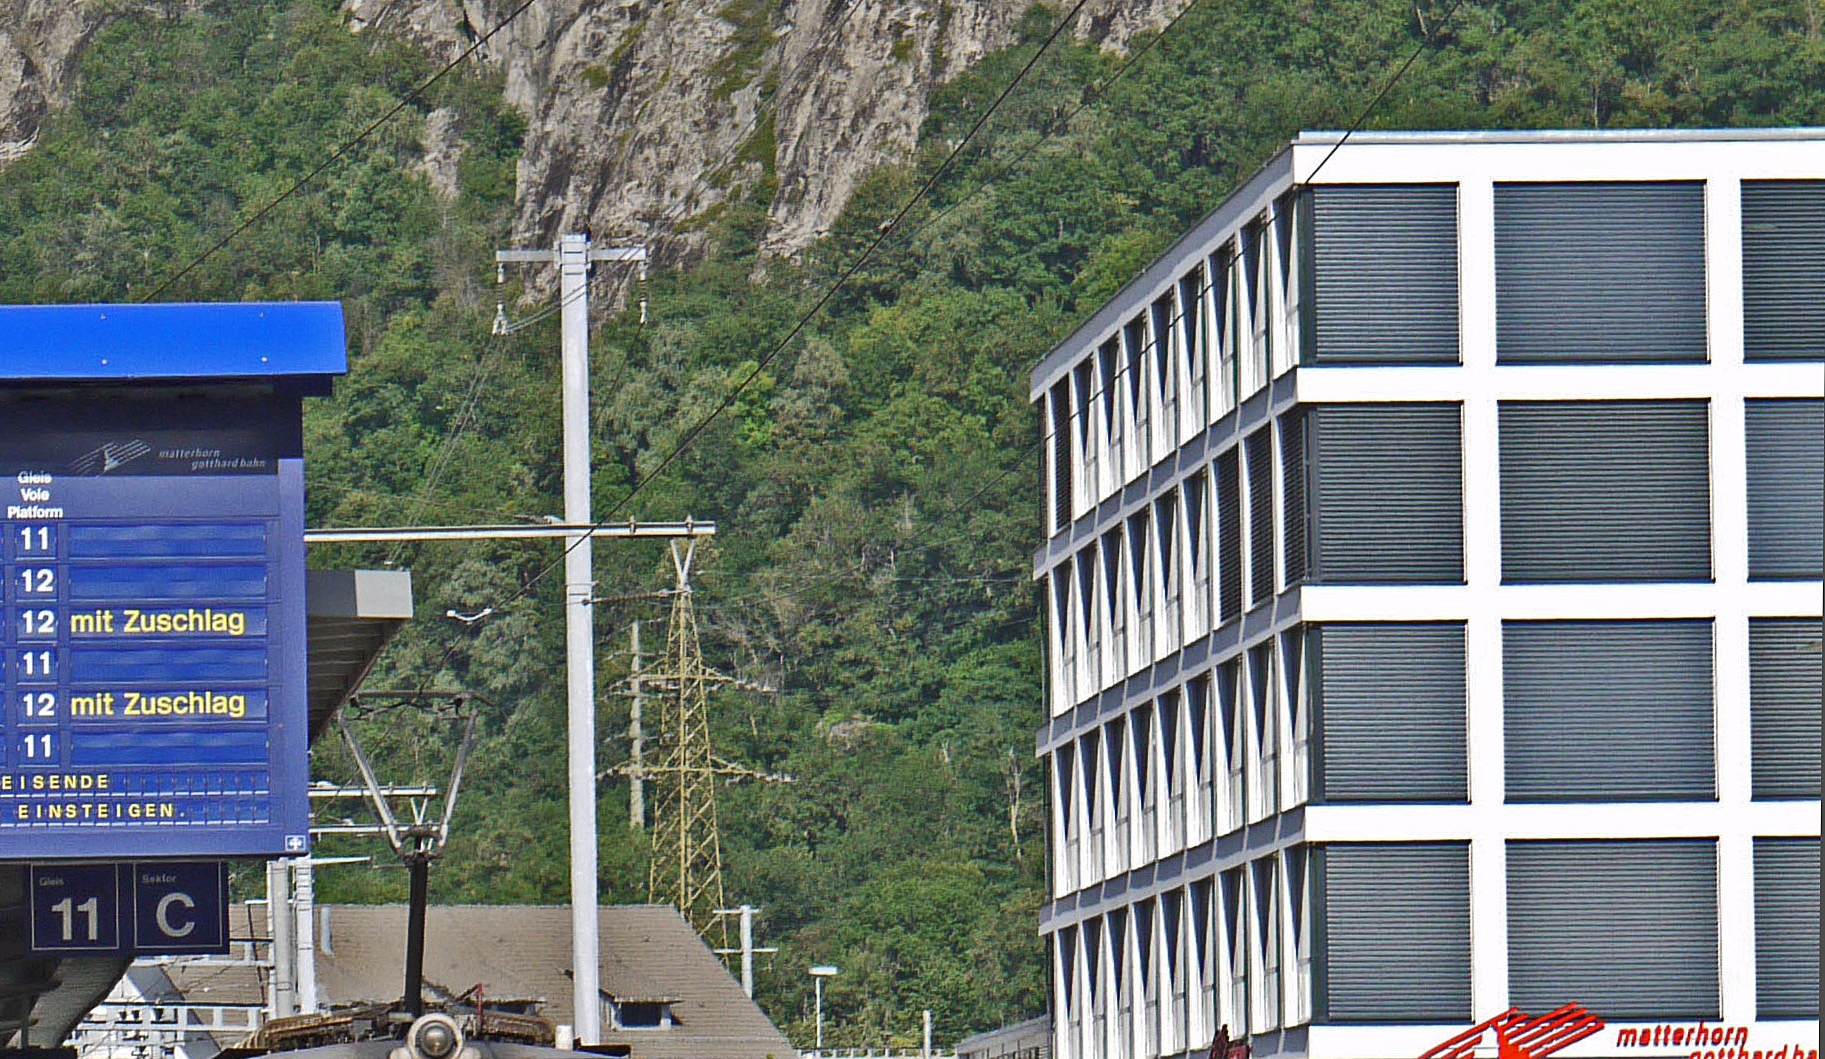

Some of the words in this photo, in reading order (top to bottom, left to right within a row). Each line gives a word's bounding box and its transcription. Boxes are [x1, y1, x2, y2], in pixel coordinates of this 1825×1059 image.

[158, 448, 220, 459] matterhorn
[16, 471, 53, 485] Gleis
[20, 487, 51, 502] Voie
[6, 505, 64, 520] Platform
[21, 526, 48, 550] 11
[21, 568, 54, 593] 12
[22, 610, 55, 634] 12
[70, 610, 114, 633] mit
[123, 608, 245, 636] Zuschlag
[22, 651, 50, 675] 11
[23, 693, 55, 717] 12
[71, 692, 114, 716] mit
[123, 691, 245, 718] Zuschlag
[24, 734, 51, 758] 11
[18, 803, 185, 819] EINSTEIGEN.
[38, 876, 66, 887] Gleis
[141, 874, 177, 885] Sektor
[50, 895, 99, 942] 11
[155, 892, 197, 938] C
[1616, 1020, 1749, 1047] matterhorn
